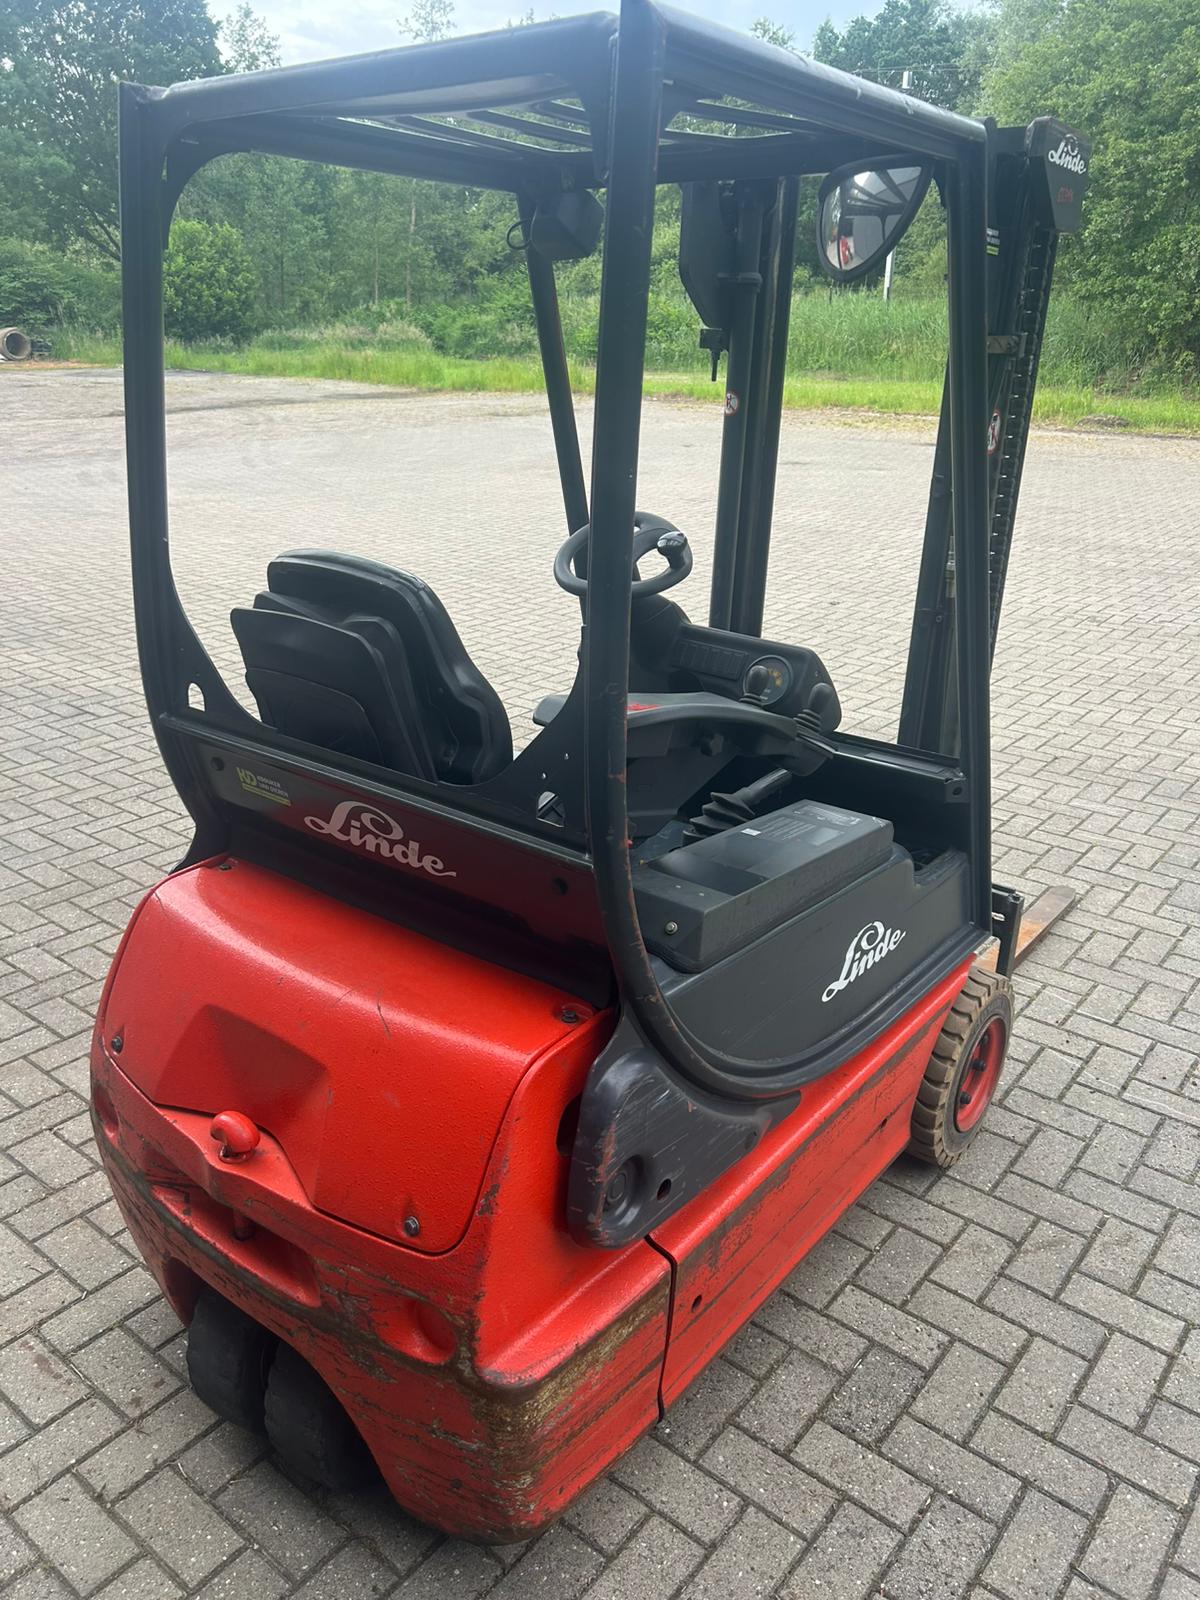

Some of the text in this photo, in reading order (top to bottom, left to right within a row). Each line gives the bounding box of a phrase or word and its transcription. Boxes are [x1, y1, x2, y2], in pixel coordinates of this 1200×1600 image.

[1048, 133, 1086, 174] Linde
[235, 767, 257, 786] KD
[303, 800, 457, 877] Linde
[821, 921, 906, 1003] Linde
